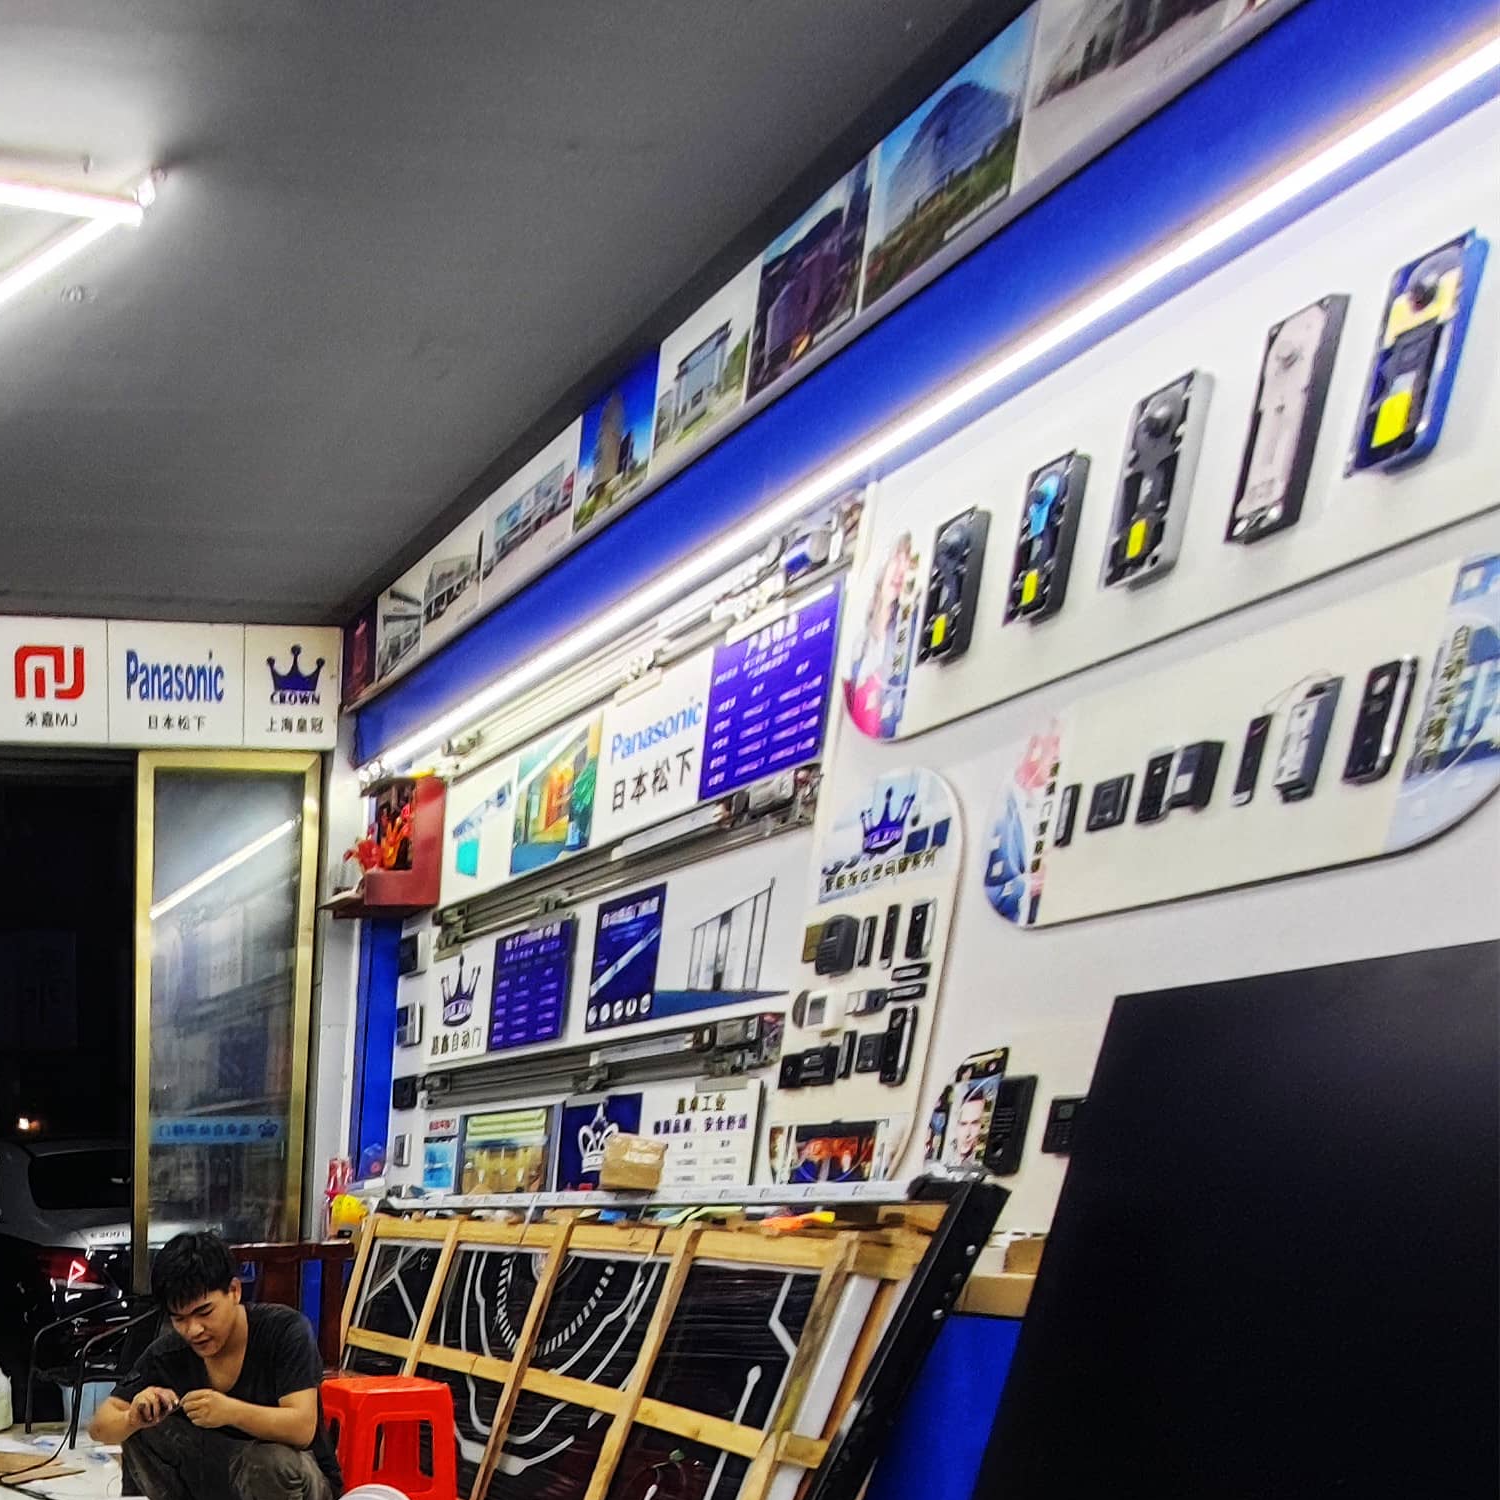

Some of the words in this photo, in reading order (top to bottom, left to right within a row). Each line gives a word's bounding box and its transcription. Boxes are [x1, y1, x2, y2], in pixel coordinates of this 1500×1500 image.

[126, 649, 225, 703] Panasonic
[270, 691, 321, 705] CROWN
[147, 713, 207, 732] 日本松下
[266, 716, 324, 734] 上海皇冠
[610, 697, 703, 764] Panasonic
[612, 747, 695, 812] 日本松下
